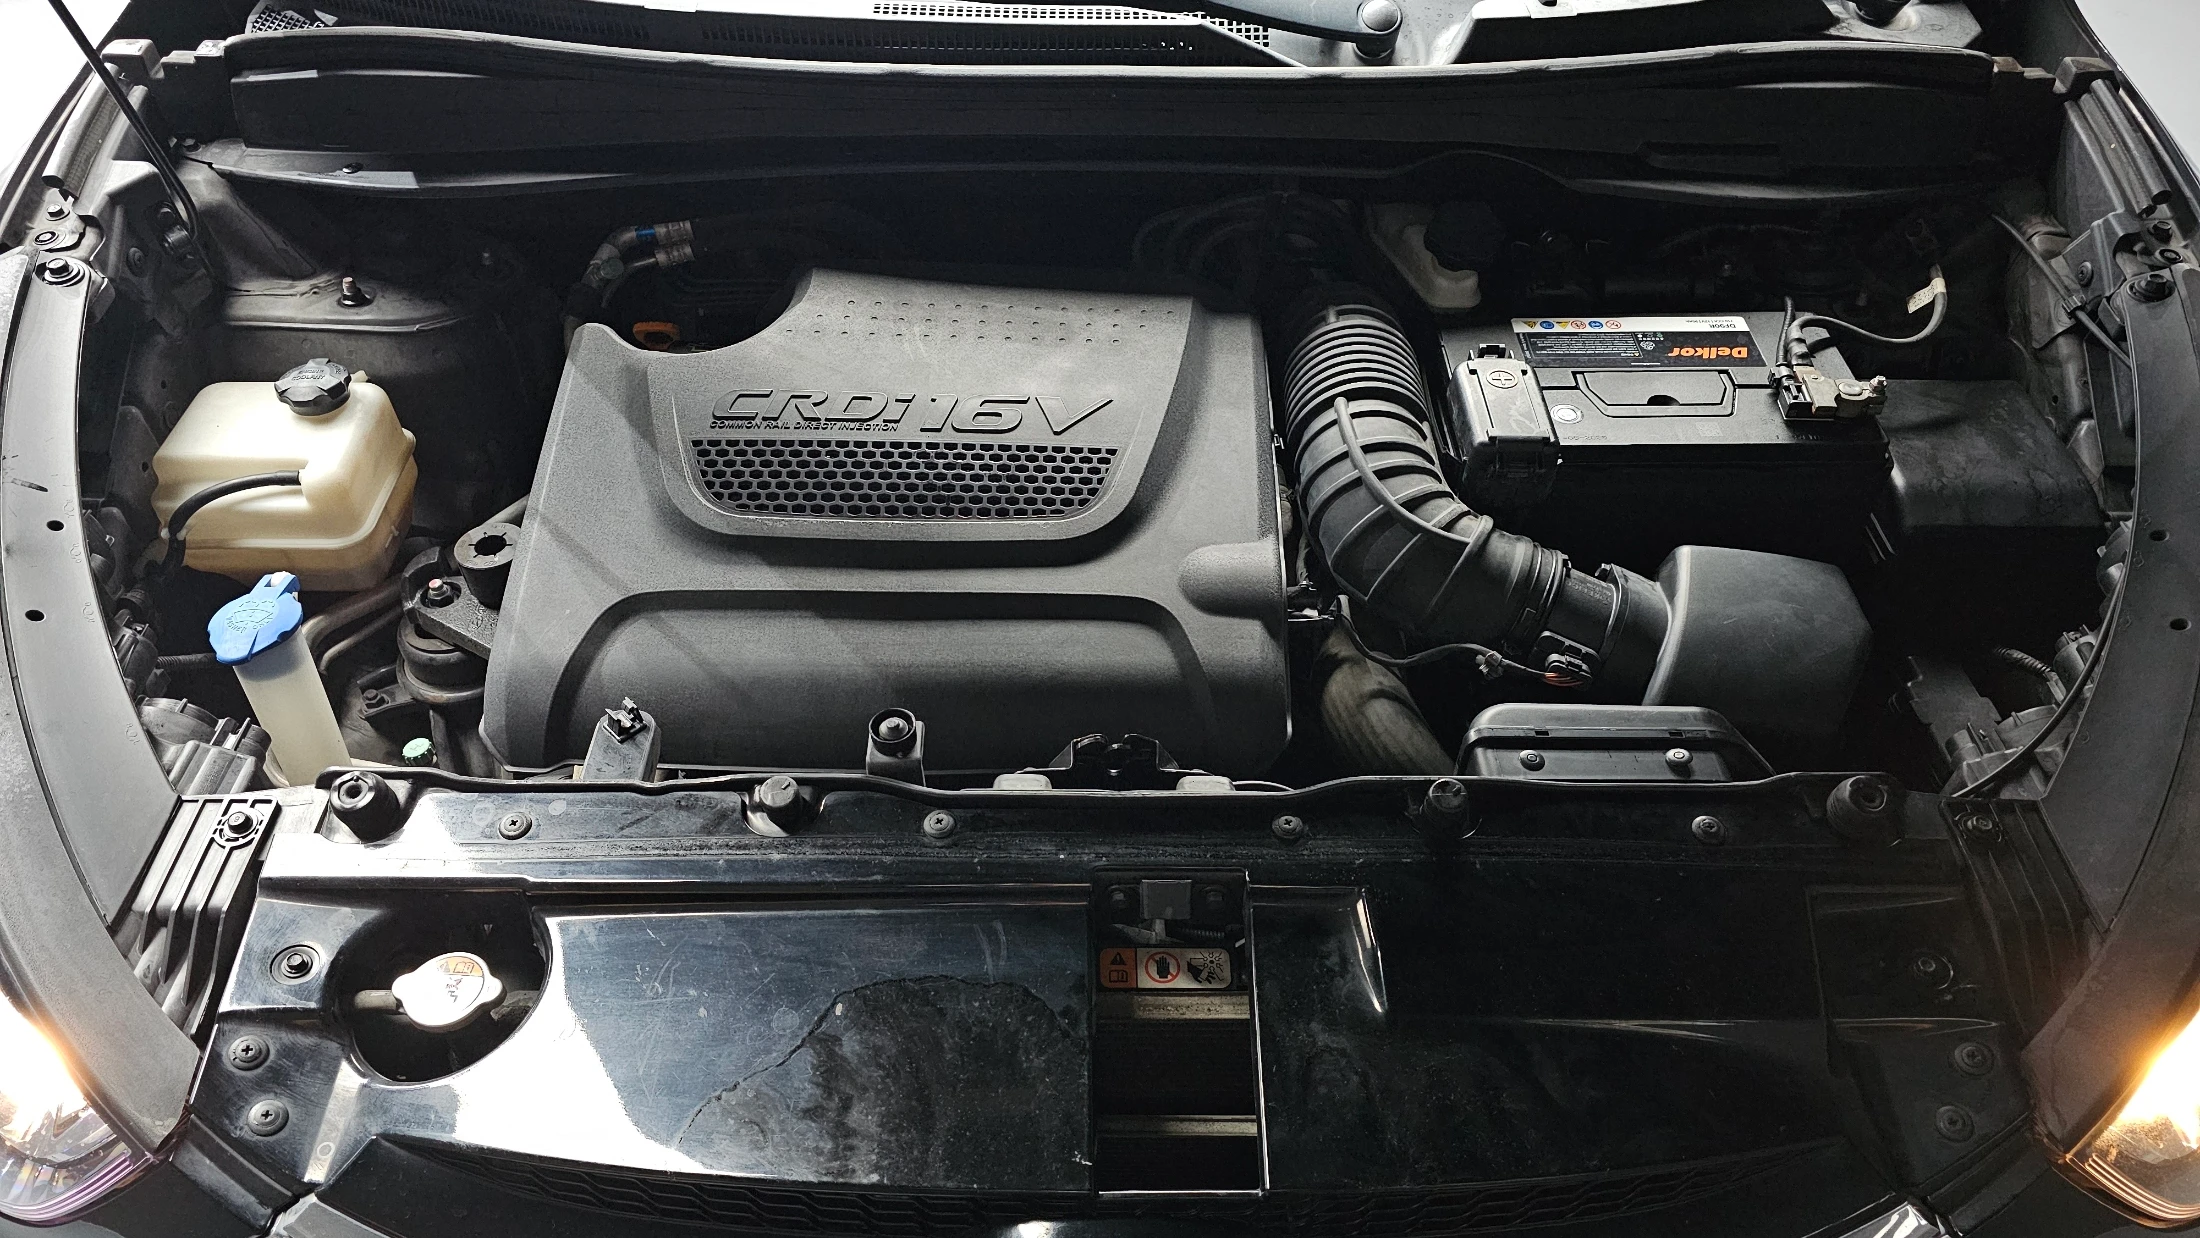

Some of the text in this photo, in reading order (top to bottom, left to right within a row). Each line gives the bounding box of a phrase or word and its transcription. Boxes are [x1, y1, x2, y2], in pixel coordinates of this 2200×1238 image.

[1667, 346, 1748, 359] Delkor
[711, 389, 1114, 436] CRDi 16V
[709, 420, 899, 432] COMMON RAIL DIRECT INJECTION
